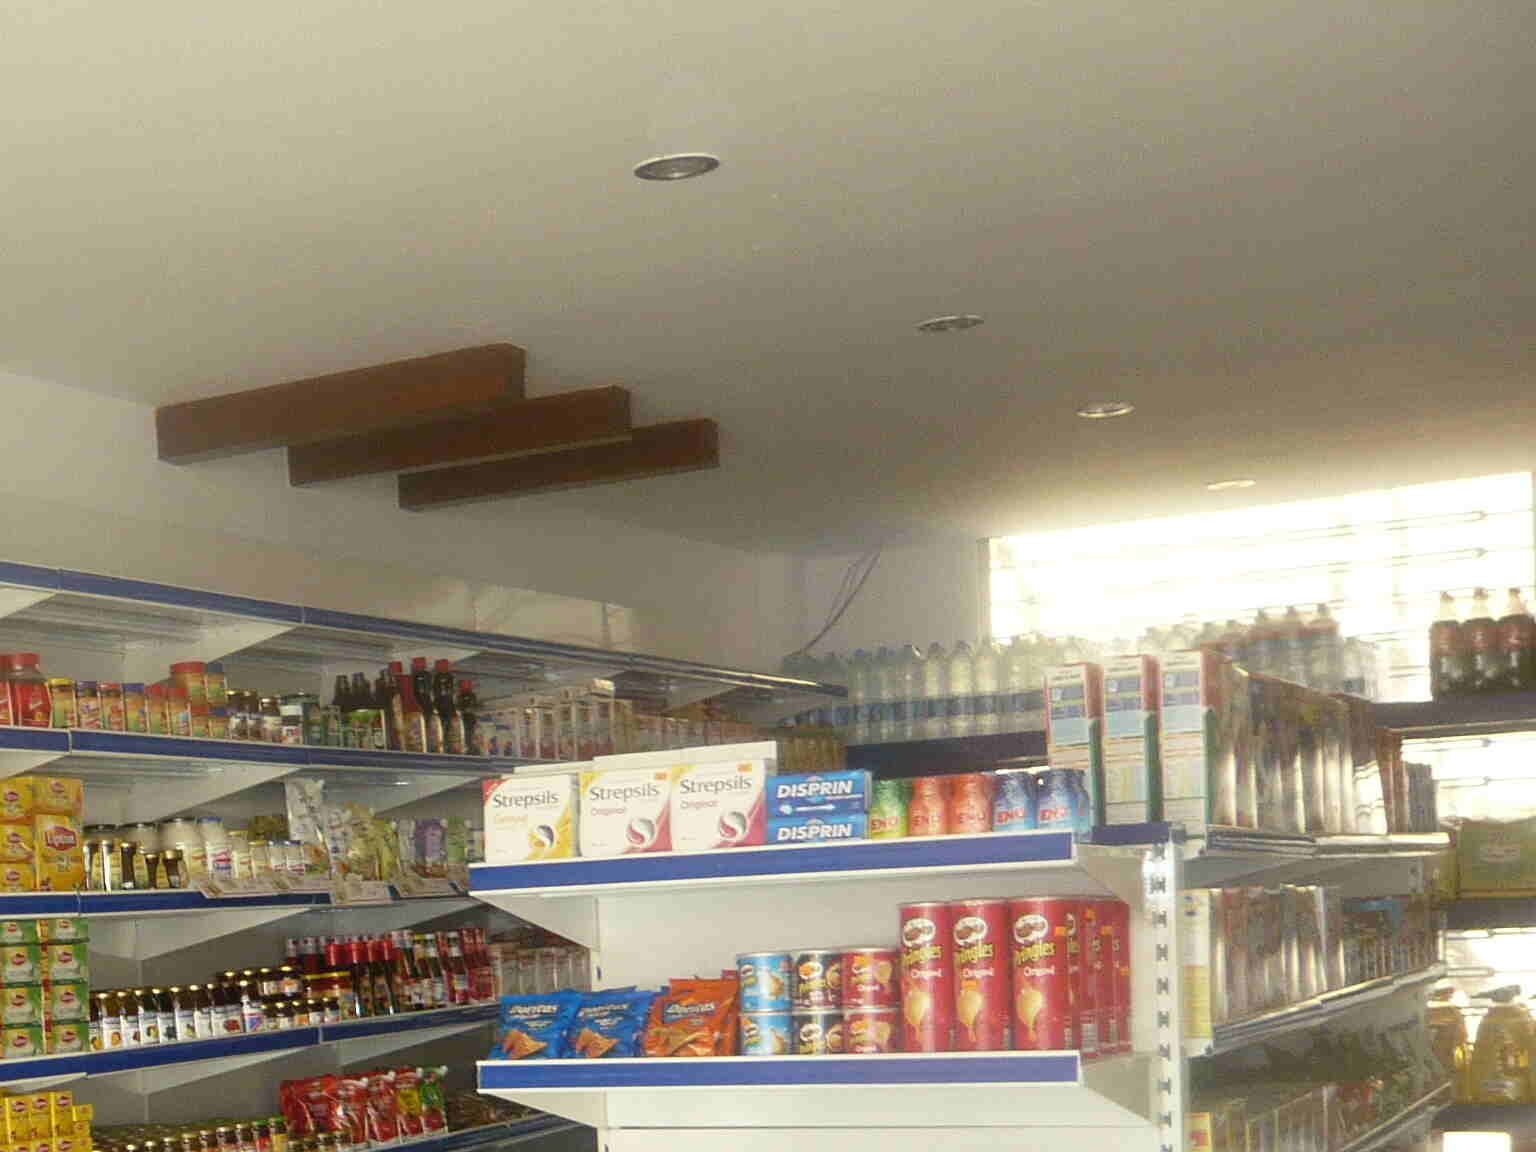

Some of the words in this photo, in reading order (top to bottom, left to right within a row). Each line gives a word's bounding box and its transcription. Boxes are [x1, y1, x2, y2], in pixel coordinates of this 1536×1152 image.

[589, 782, 661, 802] Strepsils
[680, 774, 753, 795] Strepsils
[777, 780, 853, 798] DISPRIN
[492, 790, 560, 809] Strepsils
[777, 823, 852, 841] DISPRIN
